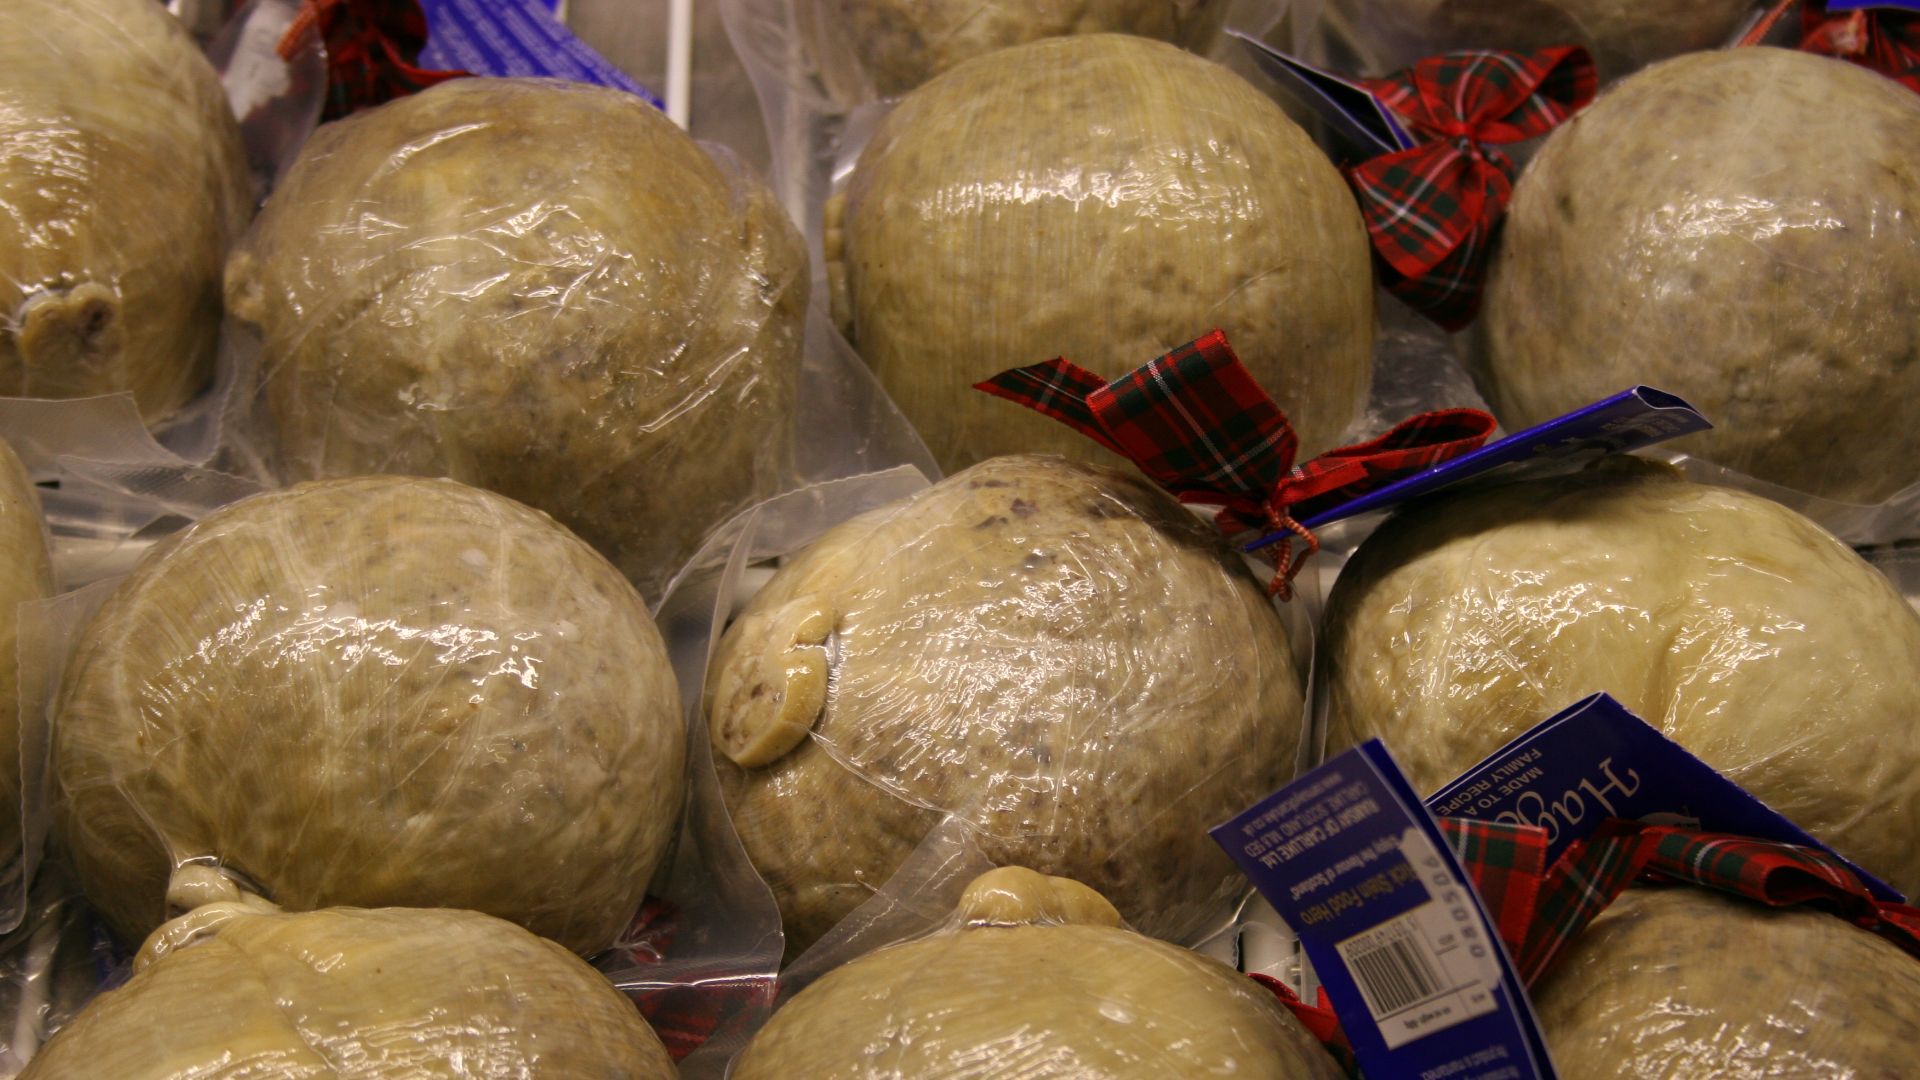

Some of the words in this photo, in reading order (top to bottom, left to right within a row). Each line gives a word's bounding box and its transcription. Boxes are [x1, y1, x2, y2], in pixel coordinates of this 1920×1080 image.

[1490, 745, 1541, 783] FAMILY
[1497, 763, 1543, 798] MADE
[1334, 796, 1380, 829] RAMSAY
[1435, 777, 1491, 818] RECIPE
[1463, 804, 1478, 819] A
[1476, 791, 1499, 811] TO
[1496, 757, 1640, 844] Hag
[1276, 824, 1327, 861] CARLUKE
[1321, 816, 1341, 837] OF
[1298, 901, 1335, 930] Hero
[1327, 887, 1364, 917] Food
